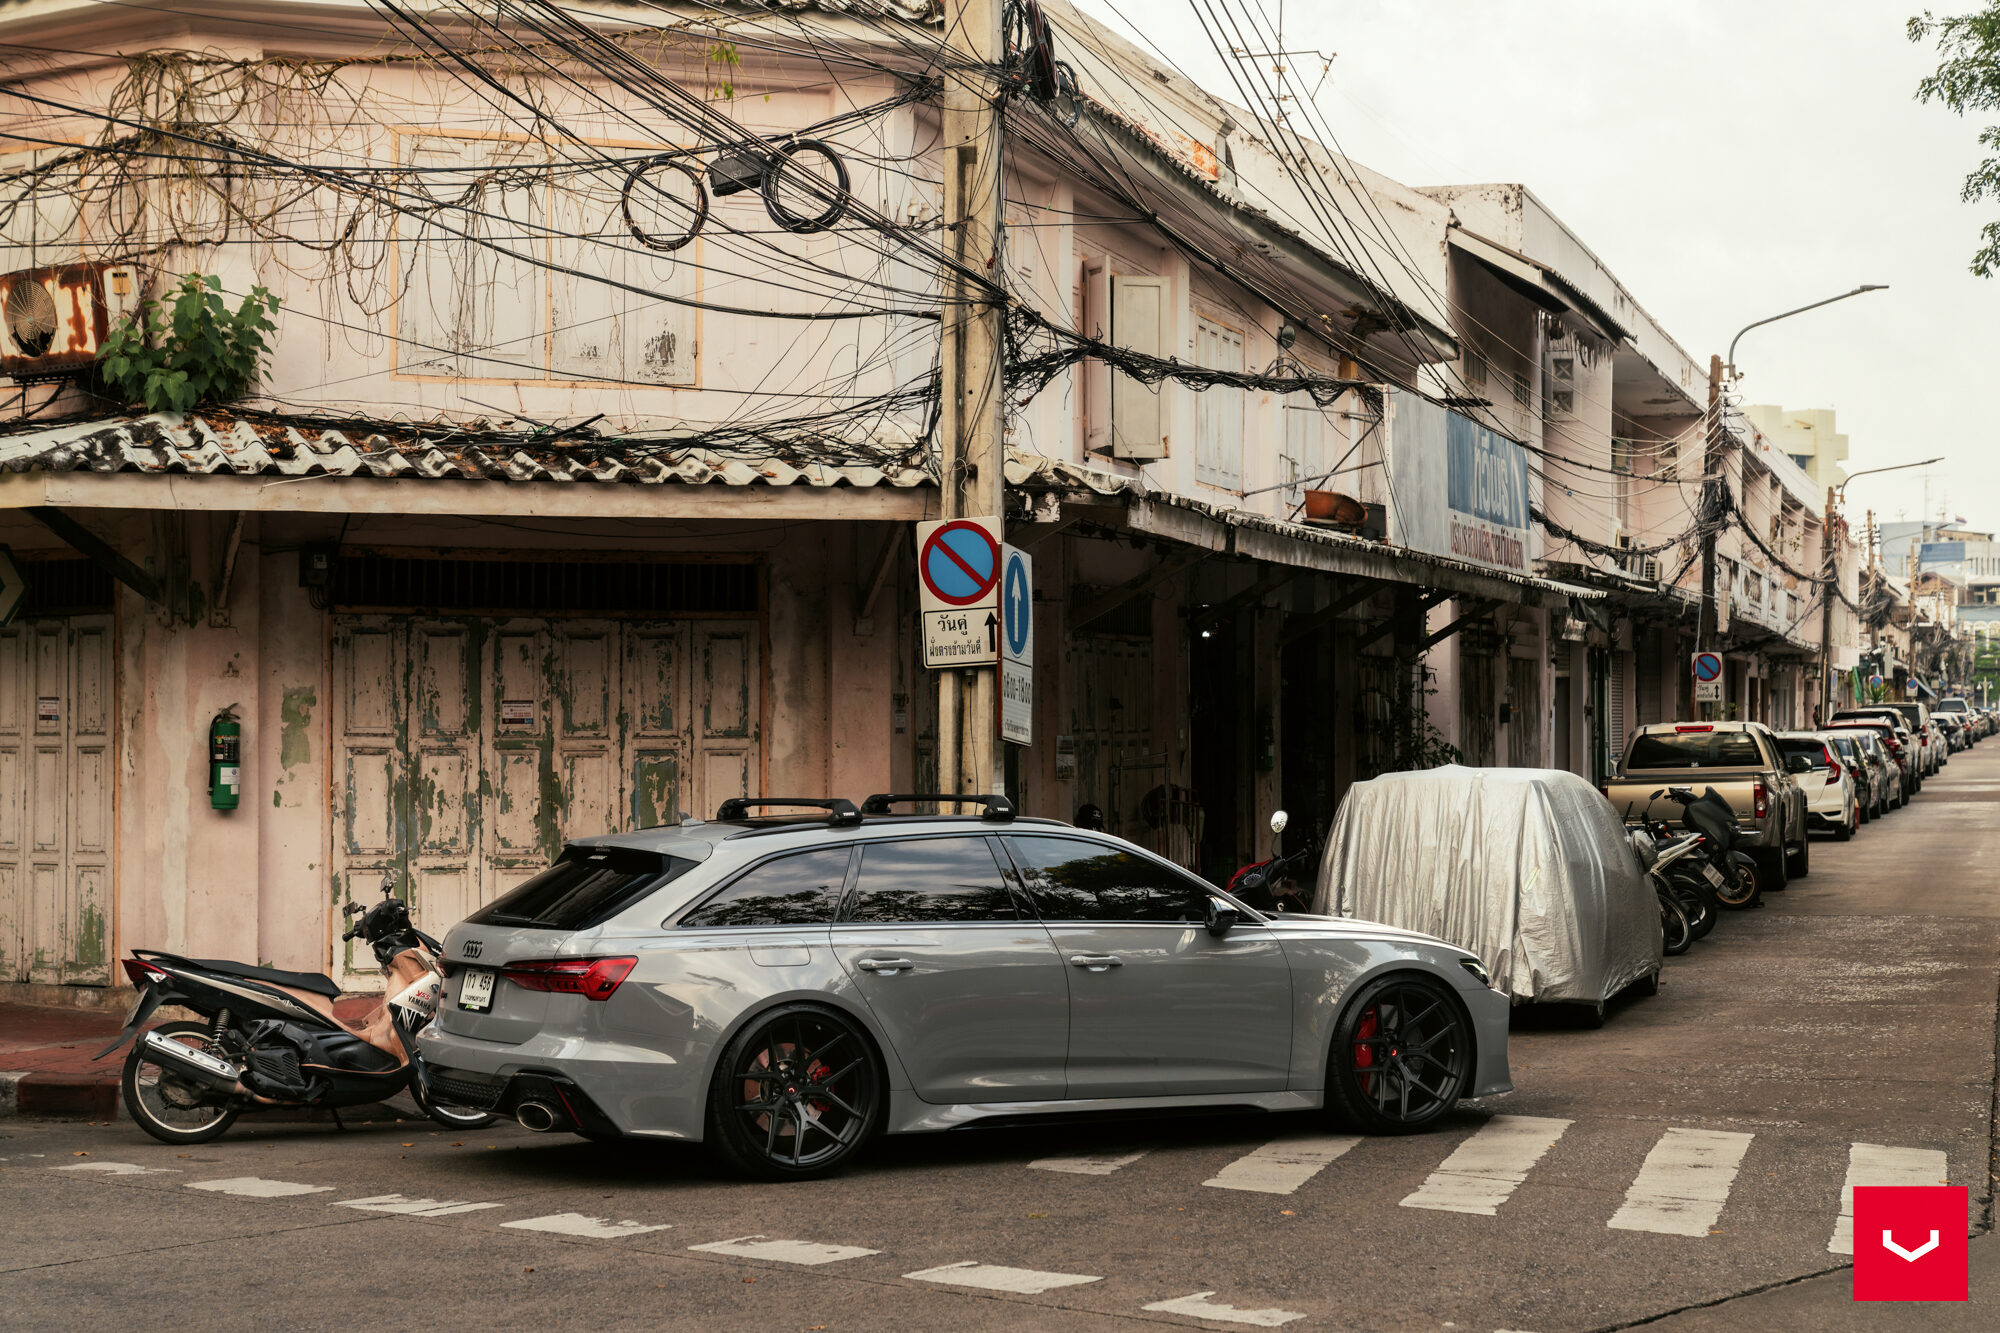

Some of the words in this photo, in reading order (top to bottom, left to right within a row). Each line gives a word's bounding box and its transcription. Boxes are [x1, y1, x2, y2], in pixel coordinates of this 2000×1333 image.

[937, 613, 968, 636] วันคู่
[929, 636, 982, 657] ฝั่งตรงข้ามวันคี่
[408, 995, 431, 1010] YAMAHA
